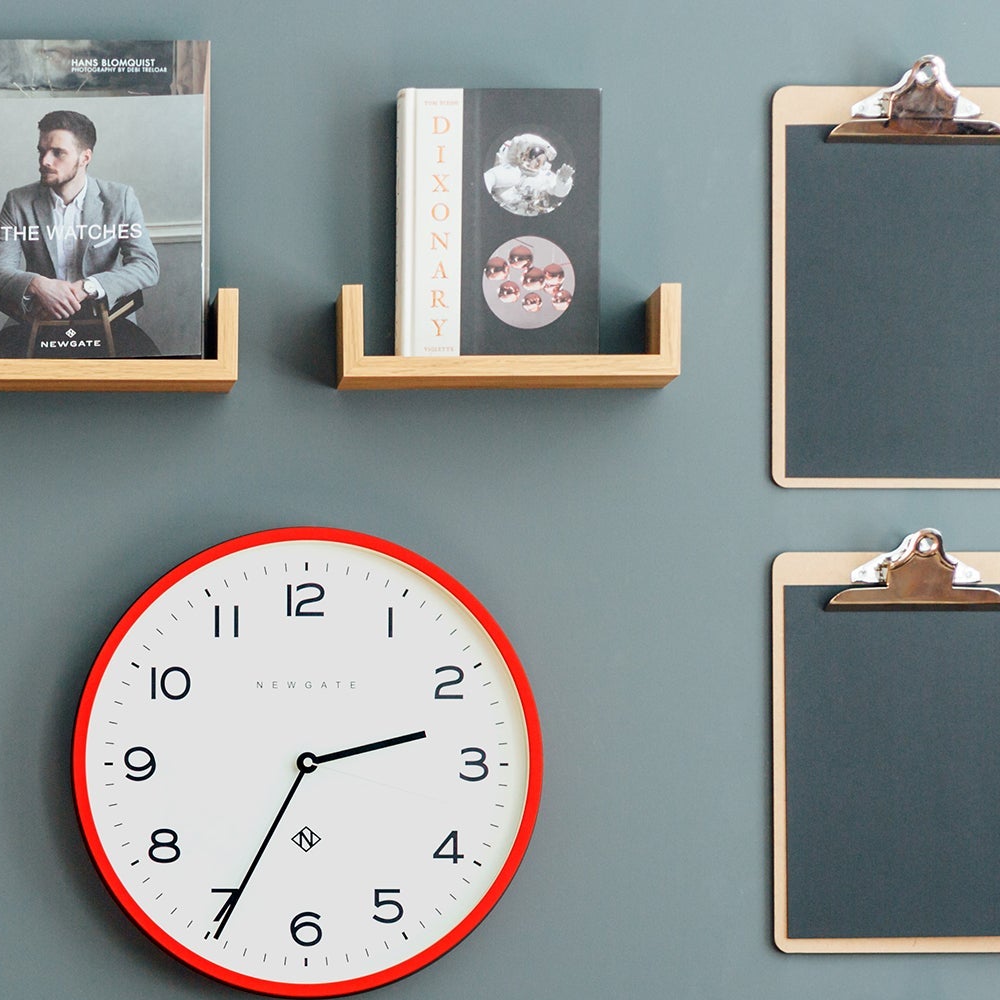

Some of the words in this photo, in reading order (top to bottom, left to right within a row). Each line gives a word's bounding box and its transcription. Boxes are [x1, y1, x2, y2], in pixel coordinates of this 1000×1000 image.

[71, 58, 98, 67] HANS
[101, 58, 156, 67] BLOMQUIST
[1, 226, 39, 241] THE
[46, 223, 143, 240] WATCHES
[431, 115, 451, 337] DIXONARY
[40, 340, 101, 348] NEWGATE
[287, 583, 325, 617] 12
[214, 605, 240, 638] 11
[388, 606, 394, 638] 1
[150, 666, 191, 700] 10
[256, 681, 356, 689] NEWGATE
[434, 666, 465, 700] 2
[124, 746, 157, 782] 9
[459, 747, 490, 782] 3
[148, 828, 181, 864] 8
[432, 831, 465, 864] 4
[211, 888, 240, 922] 7
[372, 889, 405, 924] 5
[290, 912, 323, 947] 6
